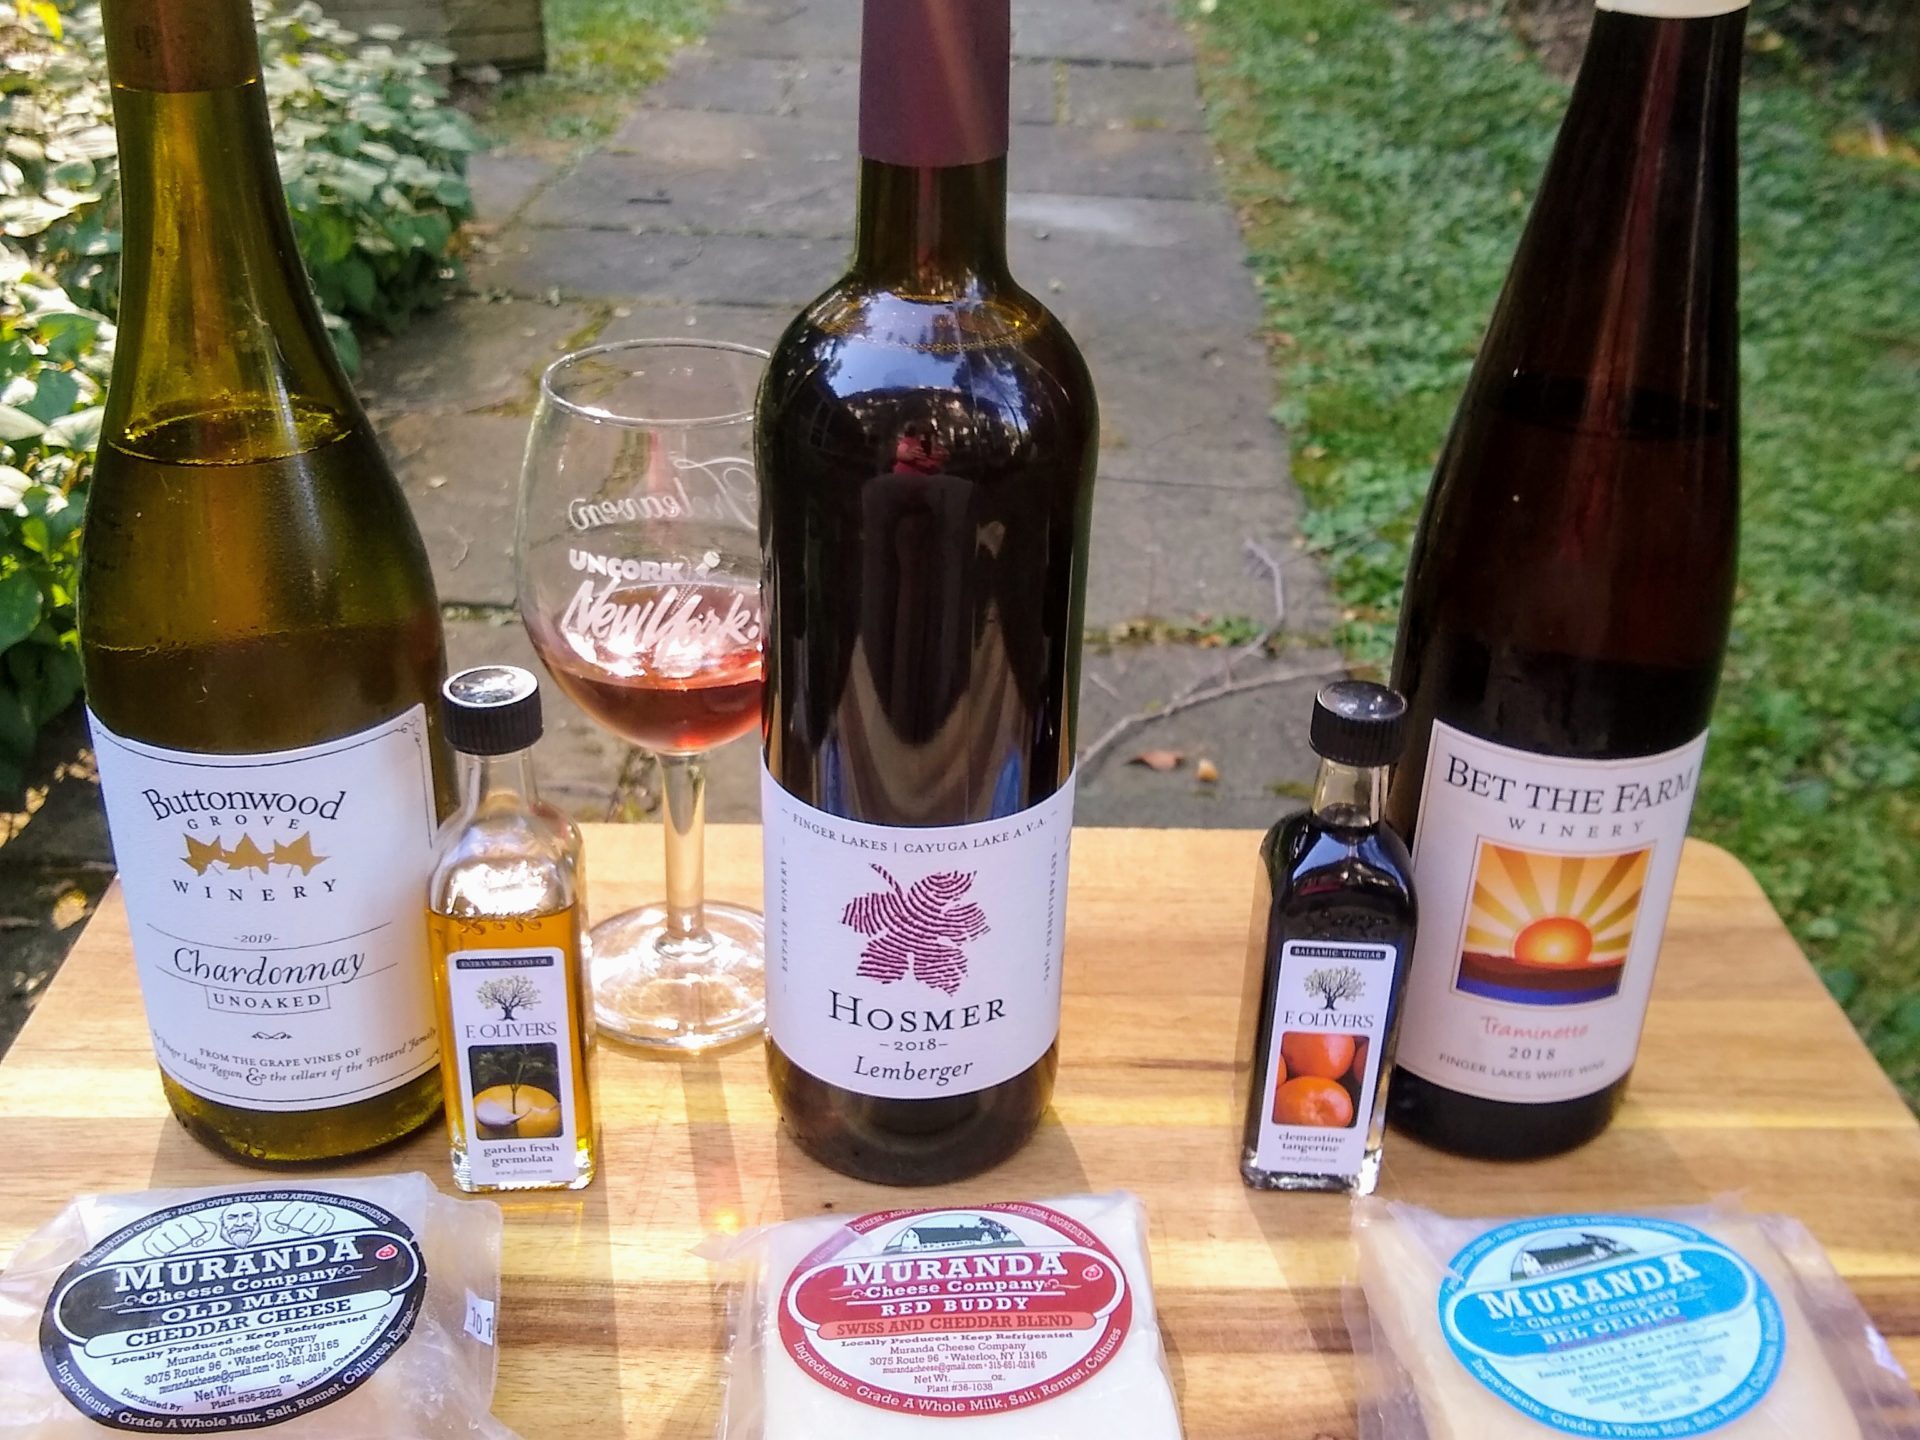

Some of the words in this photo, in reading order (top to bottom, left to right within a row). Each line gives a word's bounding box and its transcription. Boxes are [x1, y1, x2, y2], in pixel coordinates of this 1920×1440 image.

[569, 549, 685, 581] UNCORK
[1444, 754, 1517, 803] BET
[1525, 783, 1605, 815] THE
[142, 788, 346, 820] Buttonwood
[186, 814, 300, 830] GROVE
[793, 813, 837, 840] FINGER
[841, 834, 888, 851] LAKES
[904, 841, 968, 853] CAYUGA
[973, 832, 1010, 848] LAKE
[1508, 817, 1645, 838] WINERY
[172, 878, 337, 901] WINERY
[1294, 948, 1339, 957] BALSAMIC
[1341, 951, 1382, 959] VINEGAR
[174, 947, 365, 985] Chardonnay
[213, 993, 321, 1009] UNOAKED
[1480, 1015, 1589, 1039] Traminette
[199, 1047, 229, 1062] FROM
[232, 1055, 256, 1066] THE
[259, 1058, 300, 1068] GRAPE
[303, 1054, 342, 1065] VINES
[345, 1047, 361, 1058] OF
[1508, 1046, 1556, 1061] 2018
[270, 1072, 286, 1081] the
[346, 1062, 363, 1073] the
[854, 1055, 974, 1086] Lemberger
[1439, 1053, 1487, 1073] FINGER
[1491, 1067, 1531, 1080] LAKES
[1536, 1068, 1574, 1080] WHITE
[1279, 1132, 1345, 1143] clementine
[1282, 1143, 1339, 1153] tangerine
[483, 1145, 526, 1158] garden
[530, 1143, 560, 1152] fresh
[491, 1154, 553, 1168] gremolata
[134, 1211, 172, 1232] CHEESE
[178, 1203, 206, 1215] AGED
[206, 1197, 233, 1208] OVER
[241, 1194, 266, 1202] YEAR
[272, 1193, 287, 1201] NO
[288, 1193, 338, 1205] ARTIFICIAL
[338, 1199, 392, 1225] INGREDIENTS
[1049, 1214, 1096, 1248] INGREDIENTS
[115, 1236, 364, 1293] MURANDA
[843, 1252, 1067, 1286] MURANDA
[140, 1285, 225, 1305] Cheese
[232, 1267, 339, 1291] Company
[866, 1282, 941, 1299] Cheese
[946, 1279, 1045, 1293] Company
[1478, 1252, 1701, 1320] MURANDA
[162, 1300, 232, 1323] OLD
[242, 1287, 319, 1309] MAN
[881, 1301, 932, 1317] RED
[943, 1297, 1030, 1312] BUDDY
[126, 1316, 251, 1347] CHEDDAR
[257, 1299, 351, 1325] CHEESE
[837, 1322, 885, 1336] SWISS
[888, 1320, 924, 1333] AND
[930, 1316, 1013, 1331] CHEDDAR
[1016, 1314, 1073, 1328] BLEND
[1526, 1309, 1591, 1330] Cheese
[112, 1350, 164, 1366] Locally
[168, 1338, 233, 1354] Produced
[246, 1330, 281, 1342] Keep
[284, 1314, 367, 1335] Refrigerated
[841, 1339, 887, 1348] Locally
[890, 1335, 950, 1344] Produced
[961, 1334, 992, 1342] Keep
[995, 1332, 1073, 1340] Refrigerated
[890, 1345, 934, 1355] Muranda
[937, 1343, 975, 1352] Cheese
[978, 1341, 1026, 1352] Company
[1541, 1328, 1589, 1345] BEL
[144, 1373, 170, 1385] 3075
[174, 1365, 205, 1380] Route
[208, 1361, 222, 1372] 96
[234, 1351, 287, 1366] Waterloo,
[288, 1345, 304, 1357] NY
[308, 1339, 339, 1352] 13165
[167, 1351, 216, 1367] Muranda
[220, 1343, 261, 1357] Cheese
[264, 1334, 317, 1350] Company
[297, 1366, 333, 1390] Muranda
[333, 1345, 362, 1367] Cheese
[359, 1313, 389, 1345] Company
[869, 1356, 894, 1366] 3075
[896, 1354, 925, 1365] Route
[927, 1354, 939, 1363] 96
[950, 1351, 999, 1362] Waterloo,
[1001, 1351, 1015, 1360] NY
[1018, 1351, 1048, 1360] 13165
[793, 1340, 852, 1390] Ingredients:
[856, 1385, 900, 1406] Grade
[903, 1400, 915, 1409] A
[918, 1399, 965, 1412] Whole
[970, 1398, 1008, 1412] Milk,
[1008, 1391, 1041, 1406] Salt,
[1039, 1368, 1089, 1396] Rennet,
[1084, 1327, 1122, 1369] Cultures
[913, 1375, 932, 1384] Net
[933, 1373, 951, 1383] Wt.
[56, 1360, 115, 1419] Ingredients:
[118, 1412, 164, 1428] Grade
[166, 1418, 178, 1428] A
[180, 1417, 227, 1428] Whole
[230, 1412, 266, 1425] Milk,
[265, 1404, 297, 1420] Salt,
[296, 1382, 345, 1410] Rennet,
[342, 1335, 394, 1385] Cultures,
[926, 1384, 949, 1393] Plant
[121, 1388, 168, 1410] Distributed
[169, 1402, 184, 1412] By:
[194, 1389, 214, 1402] Net
[216, 1385, 236, 1397] Wt.
[211, 1399, 236, 1410] Plant
